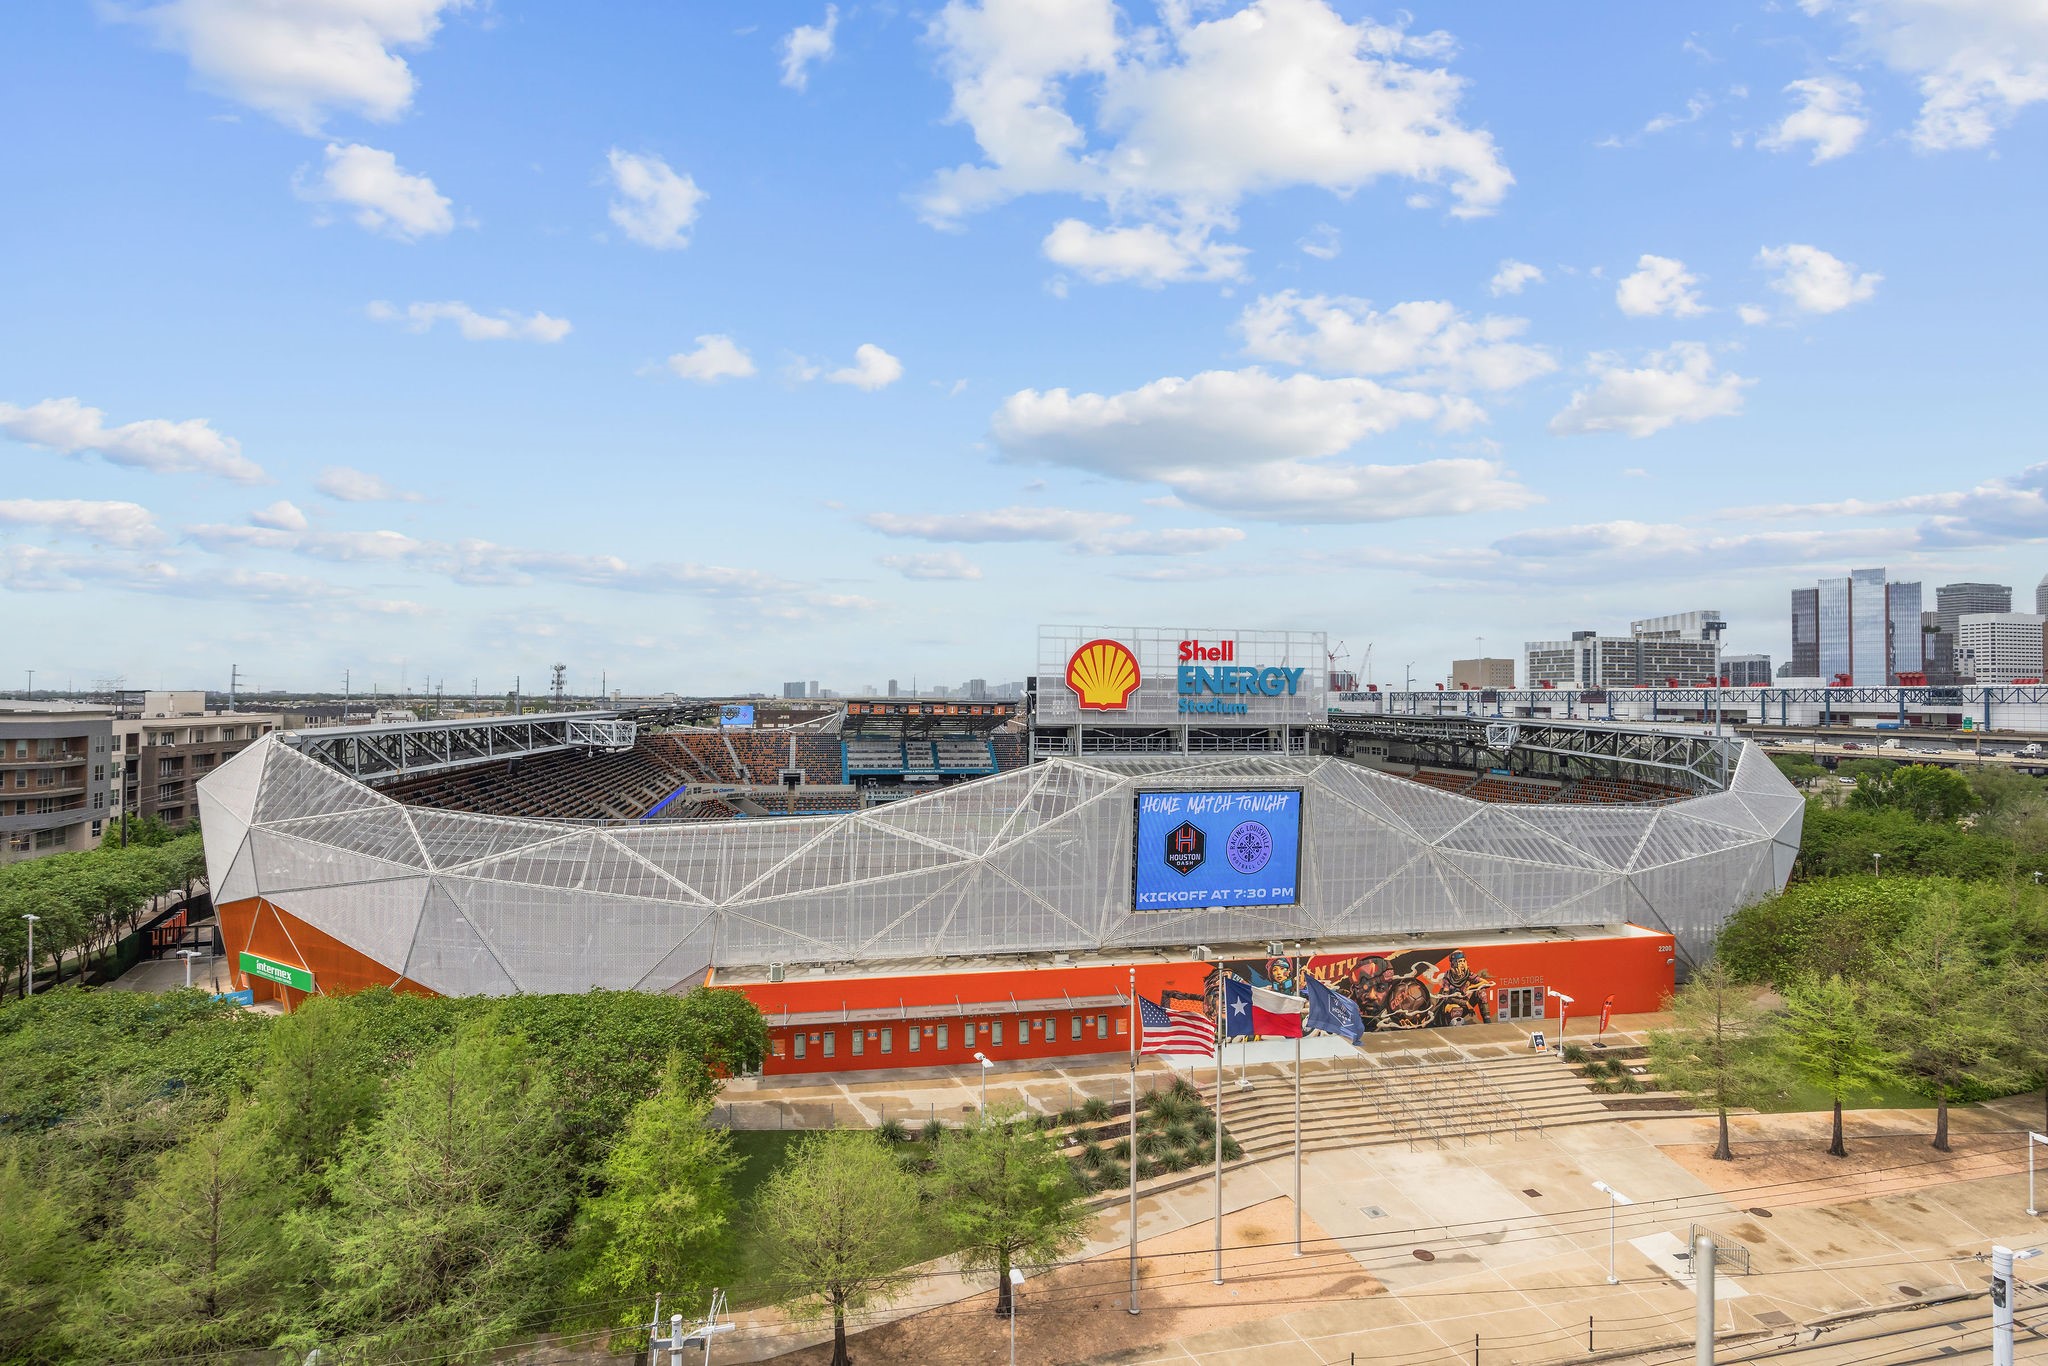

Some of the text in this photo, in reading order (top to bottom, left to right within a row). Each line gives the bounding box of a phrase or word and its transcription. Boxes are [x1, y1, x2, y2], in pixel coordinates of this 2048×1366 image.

[1178, 640, 1234, 662] Shell
[1177, 665, 1305, 697] ENERGY
[1177, 697, 1249, 715] Stadium
[1142, 794, 1289, 815] HOME MATCH TONIGHT
[1230, 824, 1270, 850] RACING LOUISVILLE
[1169, 853, 1201, 862] HOUSTON
[1139, 887, 1294, 903] KICKOFF AT 7:30 PM
[256, 960, 292, 981] intermex
[1499, 975, 1544, 986] TEAM STORE
